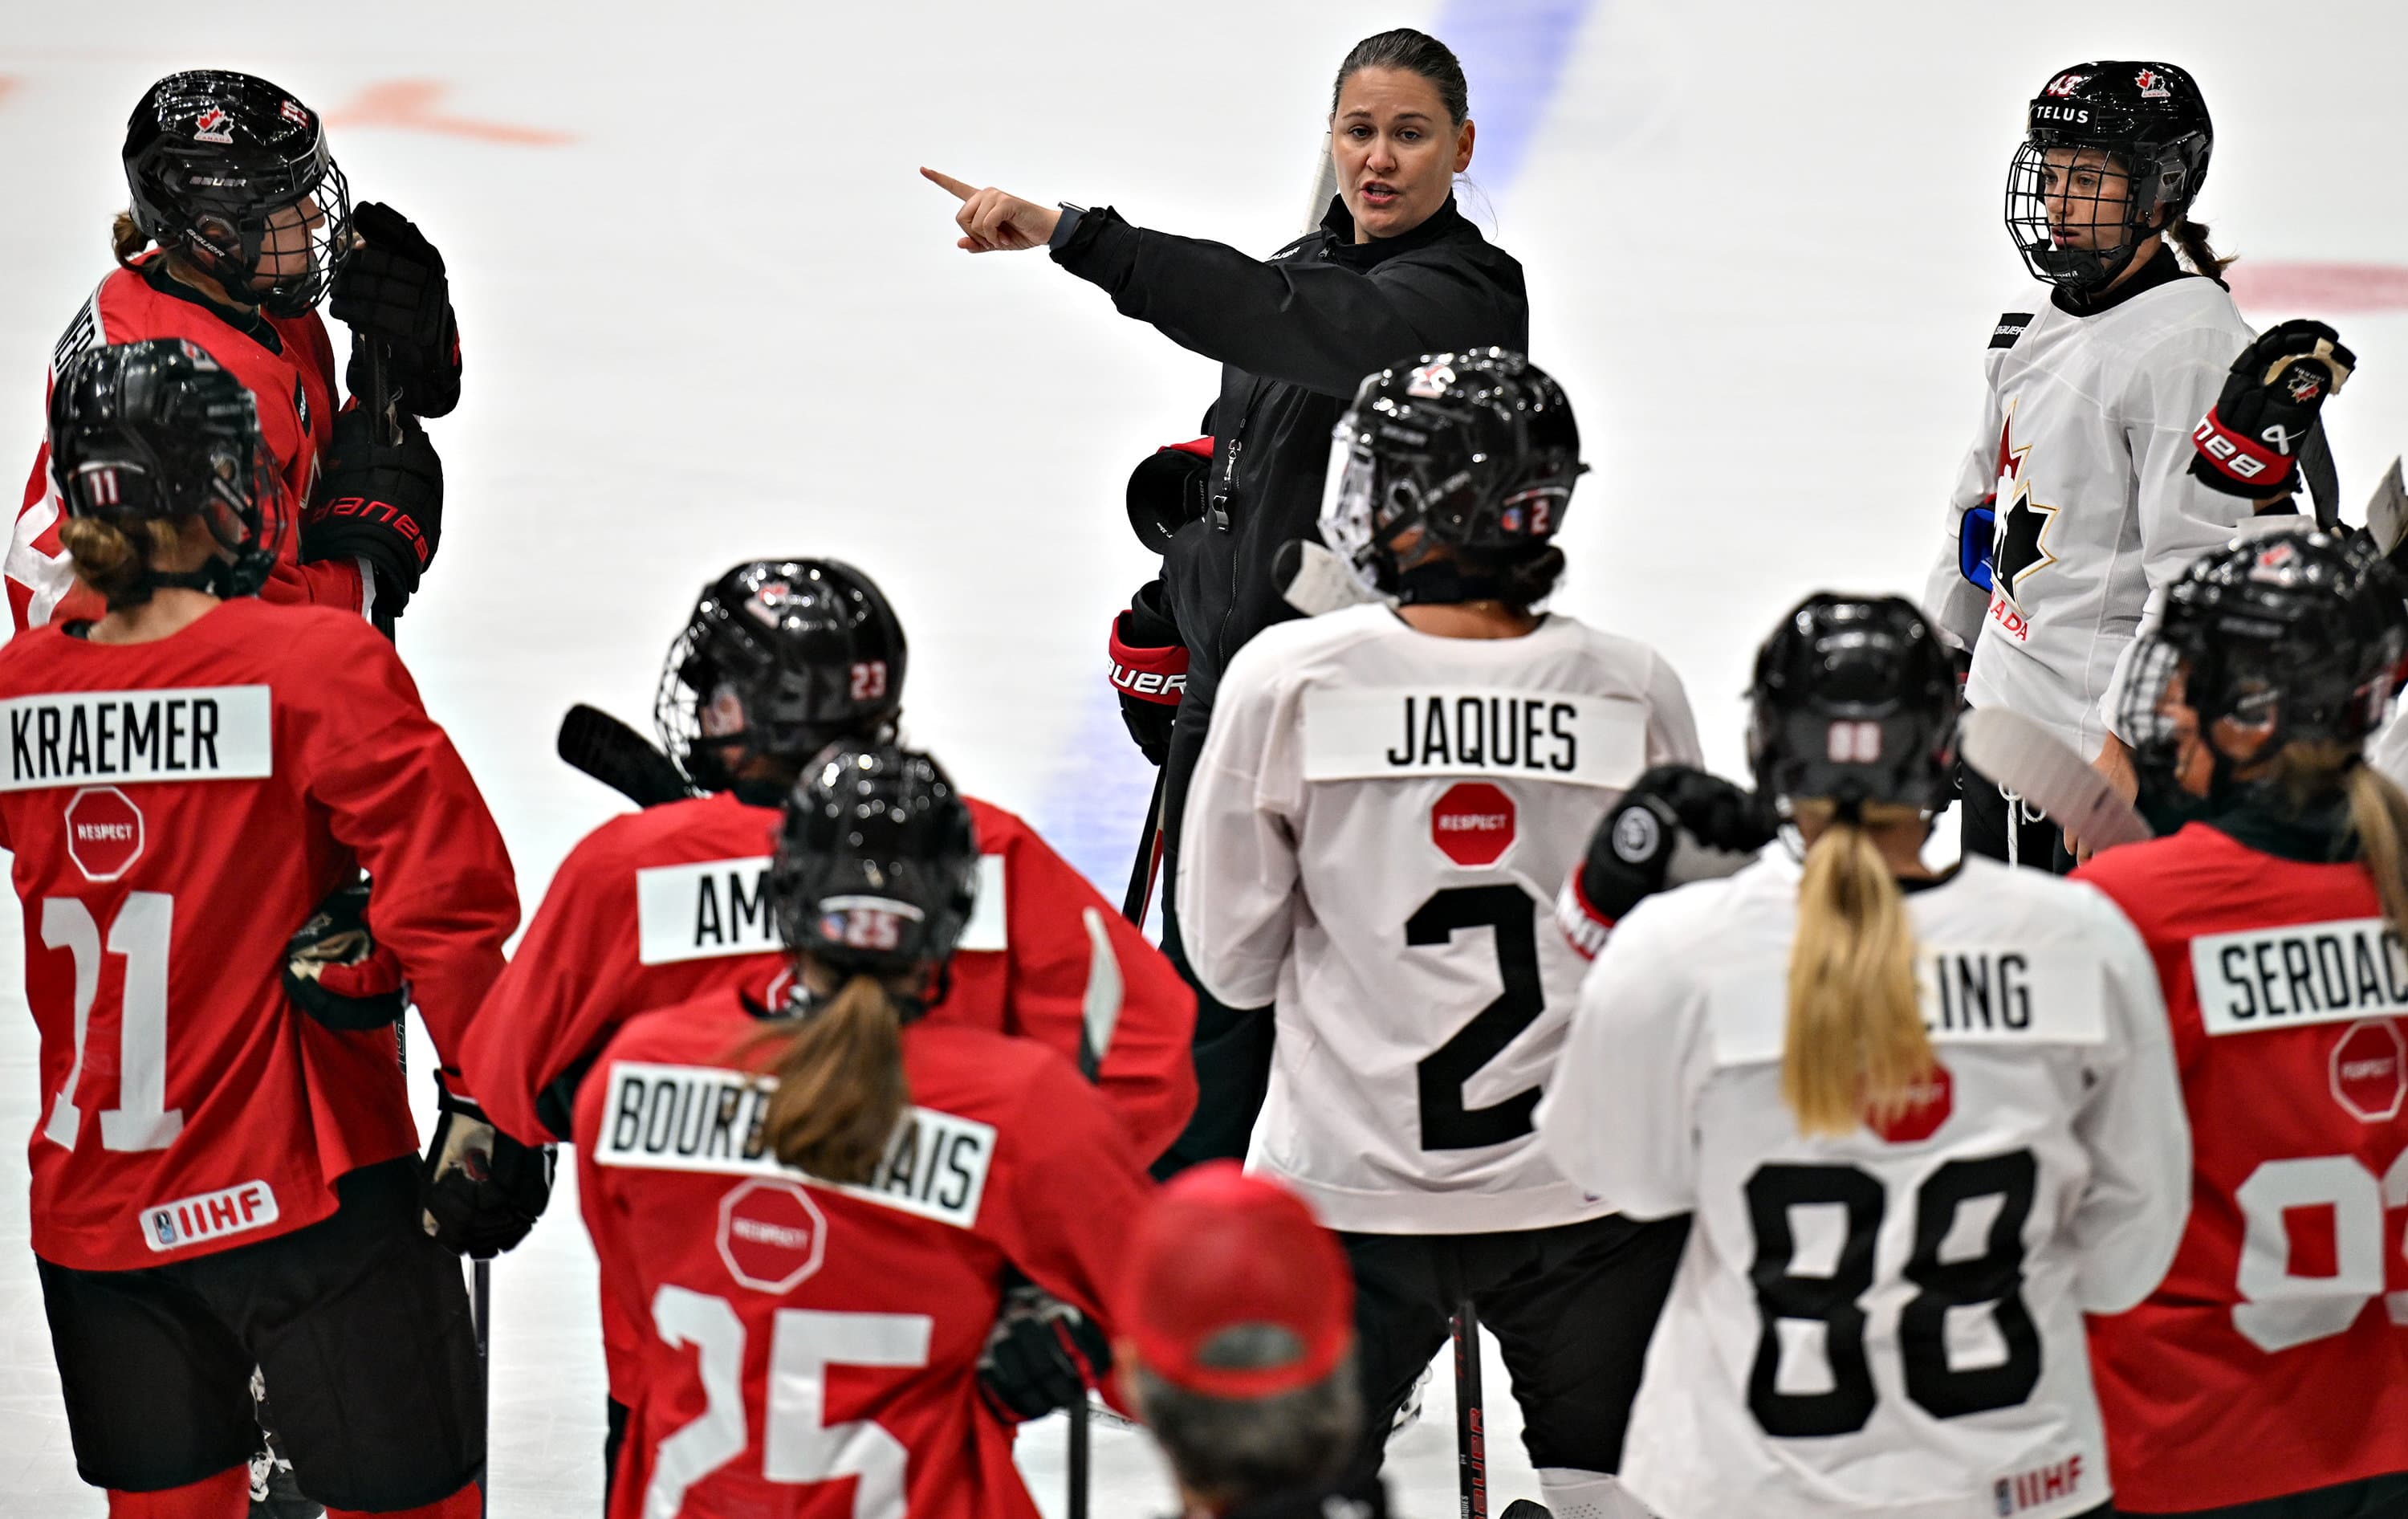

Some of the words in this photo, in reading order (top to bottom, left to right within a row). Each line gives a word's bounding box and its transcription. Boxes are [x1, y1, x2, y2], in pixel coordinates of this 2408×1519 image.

[2047, 74, 2082, 97] 43
[2036, 106, 2089, 124] TELUS
[189, 176, 246, 187] BAUER
[185, 227, 226, 257] BAUER
[89, 469, 118, 506] 11
[1531, 497, 1550, 534] 2
[850, 661, 886, 700] 23
[11, 698, 219, 780] KRAEMER
[1387, 696, 1576, 772] JAQUES
[77, 822, 132, 841] RESPECT
[1438, 814, 1507, 831] RESPECT
[40, 891, 184, 1152] 11
[1405, 884, 1545, 1151] 2
[612, 1076, 980, 1211] BOURBAIS
[181, 1187, 262, 1239] IIHF
[2231, 1143, 2408, 1354] 9
[1743, 1146, 2044, 1438] 88
[642, 1283, 934, 1519] 25
[1470, 1407, 1487, 1519] AUER
[2016, 1454, 2083, 1510] IIHF
[1460, 1494, 1470, 1519] AQUES
